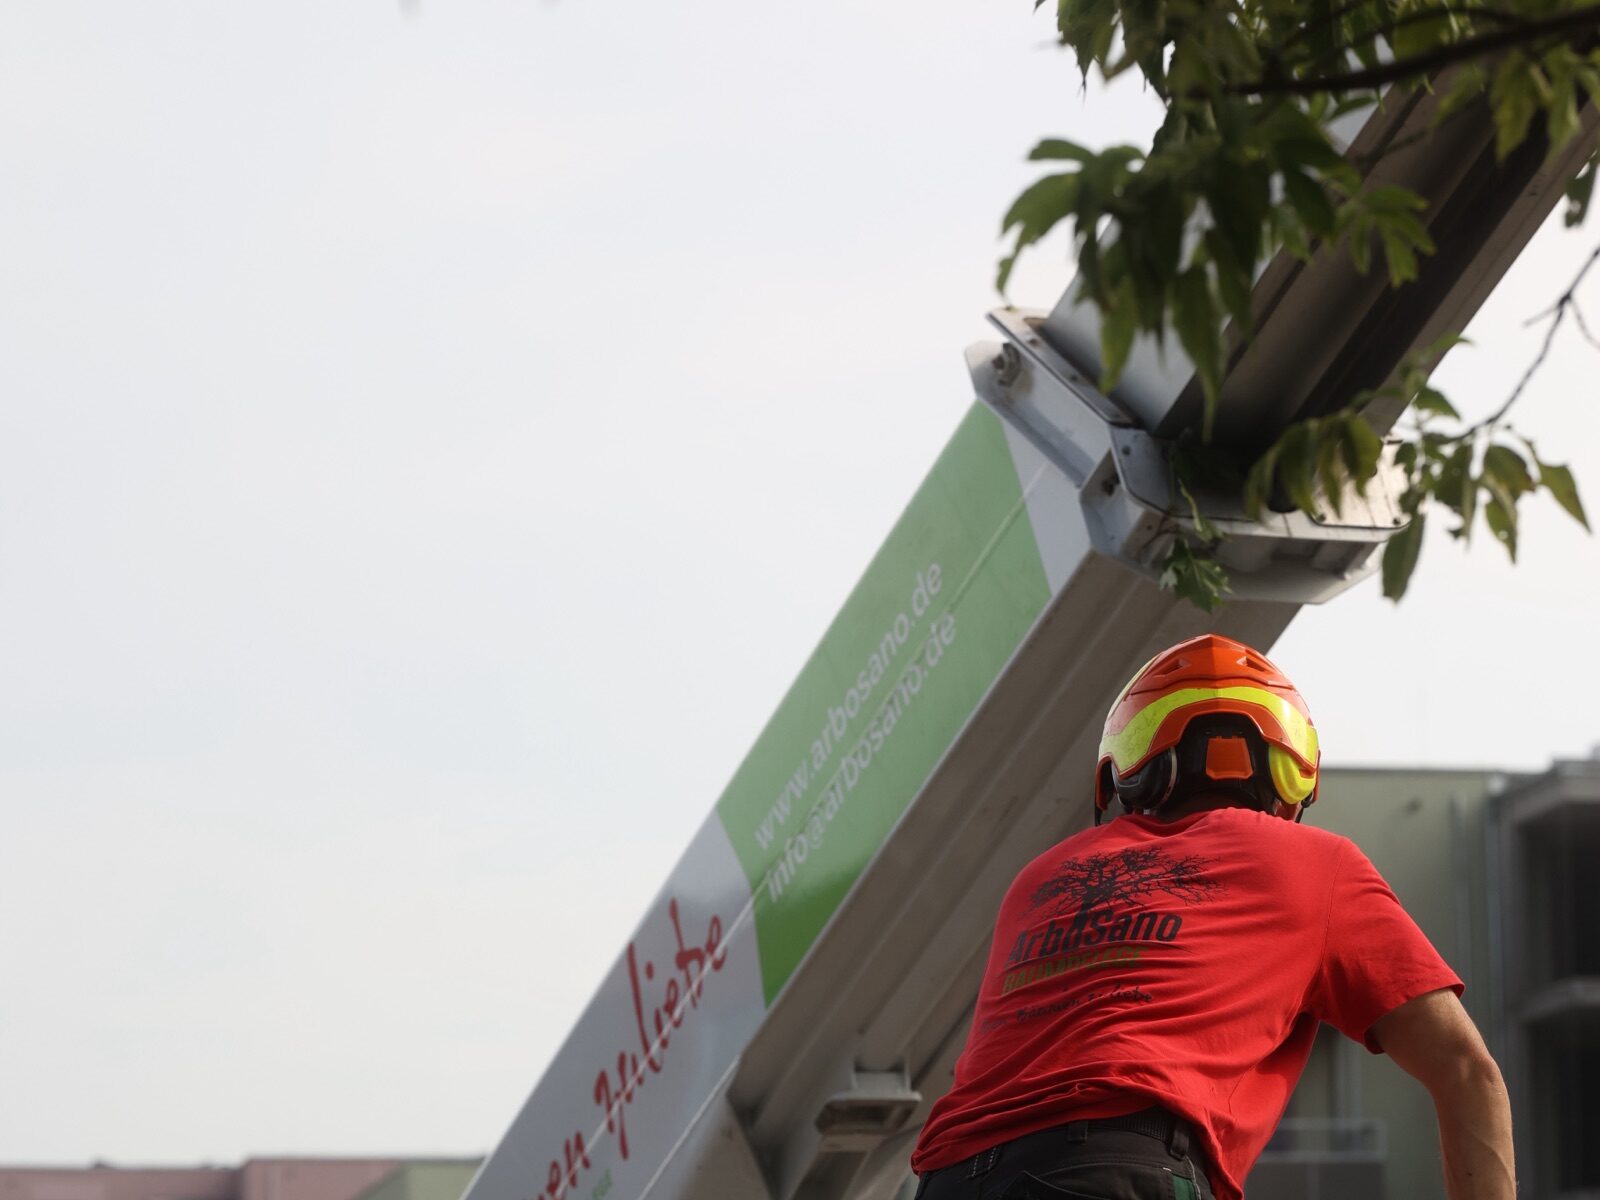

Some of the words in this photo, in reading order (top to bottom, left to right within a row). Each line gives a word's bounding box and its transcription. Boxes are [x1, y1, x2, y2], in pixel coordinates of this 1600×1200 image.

[753, 562, 942, 851] www.arbosano.de
[767, 611, 958, 902] info@arbosano.de
[594, 897, 728, 1161] zuliebe
[1006, 906, 1183, 964] ArboSano
